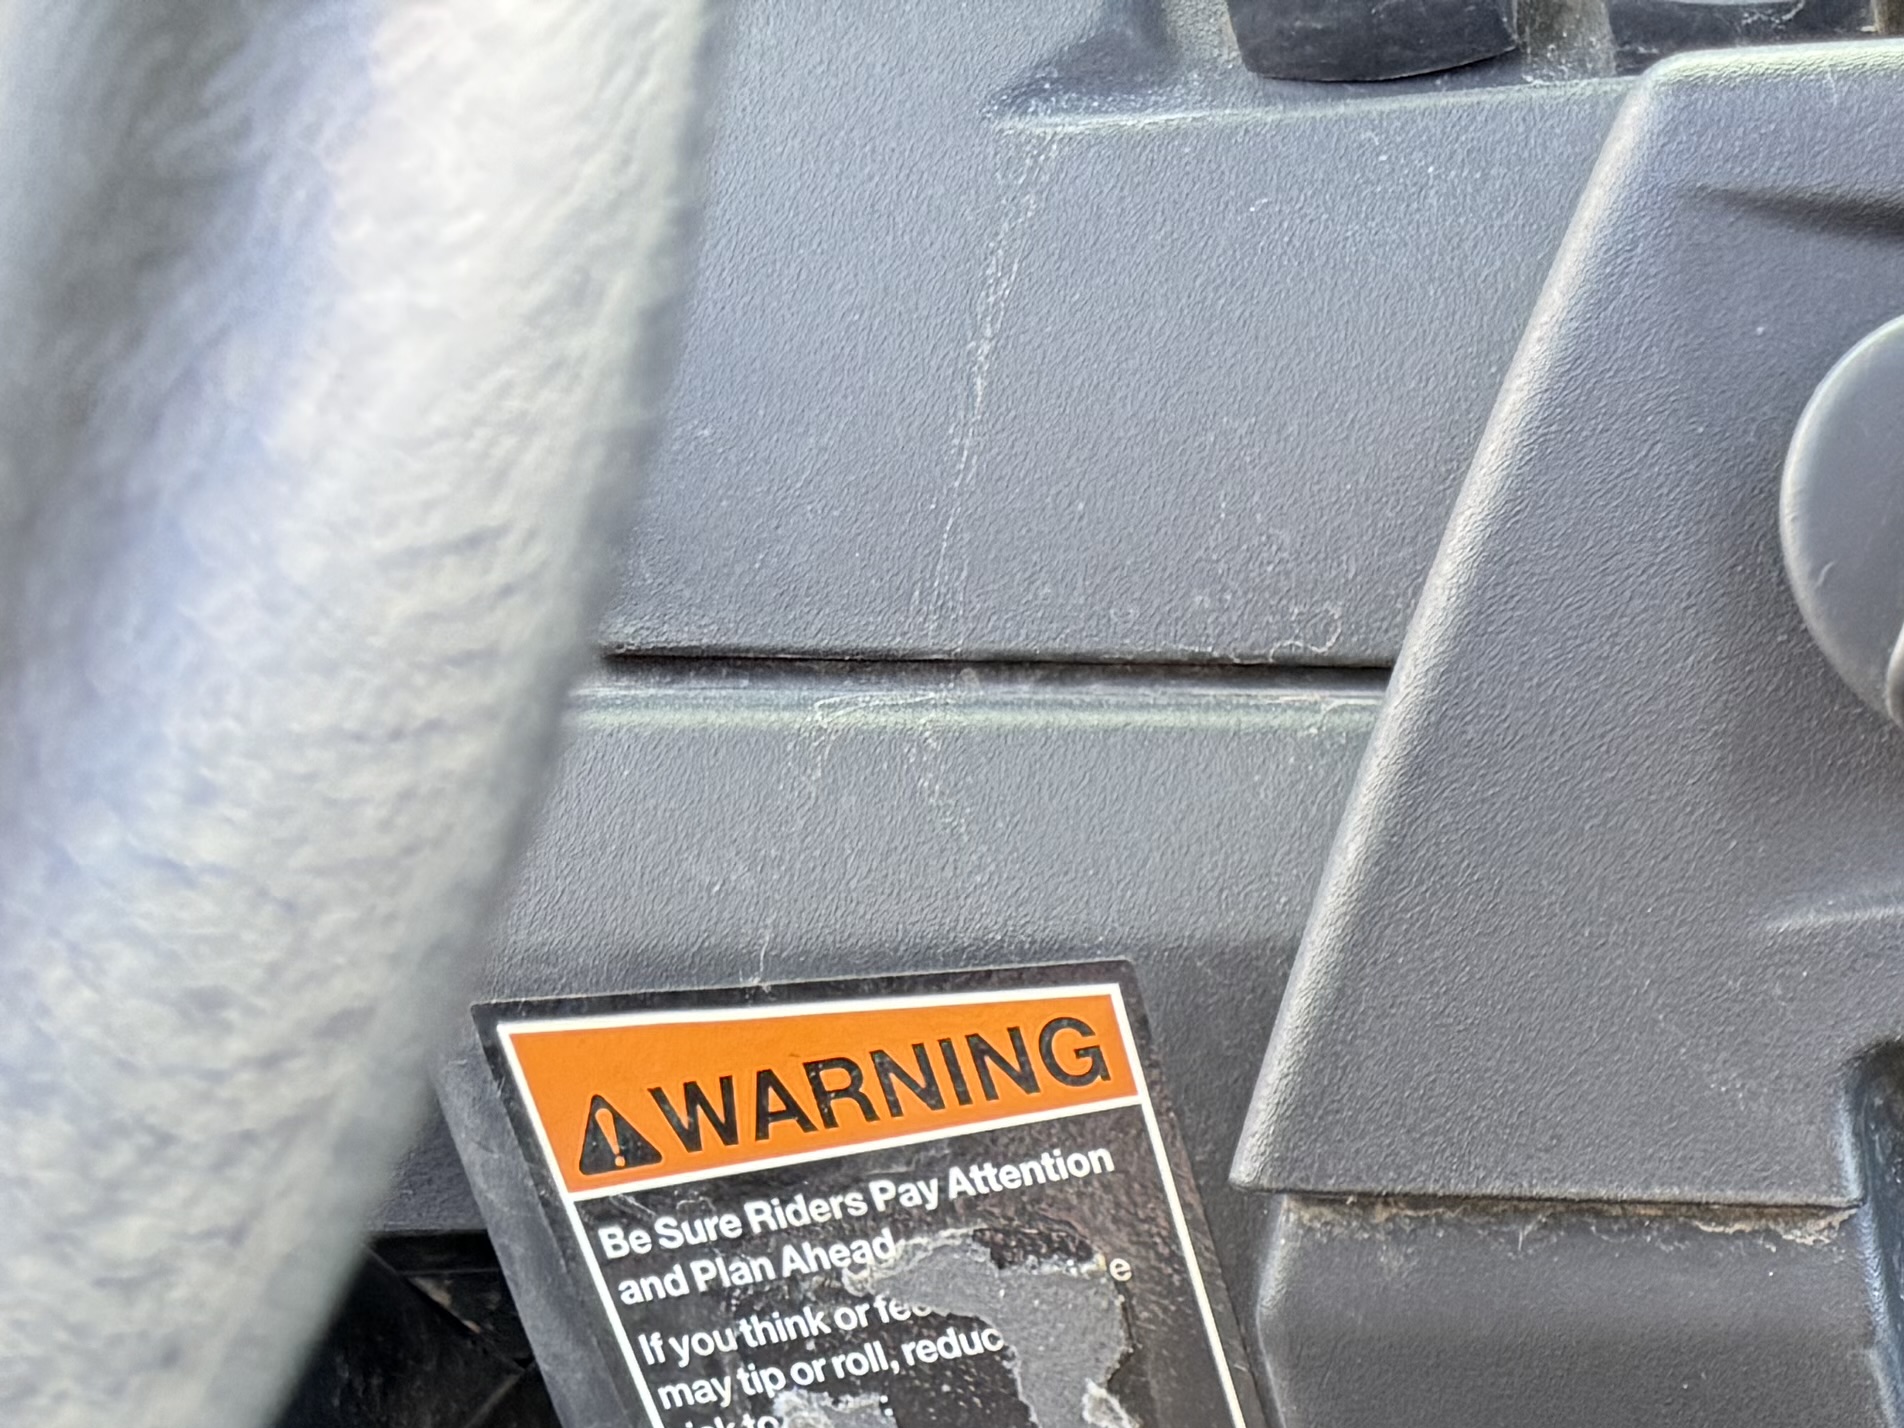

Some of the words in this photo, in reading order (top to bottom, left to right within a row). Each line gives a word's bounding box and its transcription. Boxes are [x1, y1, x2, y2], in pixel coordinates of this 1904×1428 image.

[647, 1016, 1112, 1154] WARNING
[598, 1225, 653, 1260] Be
[653, 1212, 743, 1250] Sure
[743, 1190, 869, 1235] Riders
[868, 1175, 940, 1212] Pay
[949, 1146, 1116, 1200] Attention
[617, 1263, 691, 1306] and
[690, 1253, 777, 1293] Plan
[781, 1227, 896, 1279] Ahead
[638, 1331, 664, 1366] If
[668, 1325, 739, 1368] you
[738, 1305, 832, 1349] think
[834, 1302, 872, 1331] or
[873, 1292, 933, 1325] fe
[656, 1374, 733, 1410] may
[736, 1362, 787, 1399] tip
[789, 1357, 829, 1388] or
[833, 1340, 900, 1381] roll,
[900, 1325, 1005, 1367] reduc
